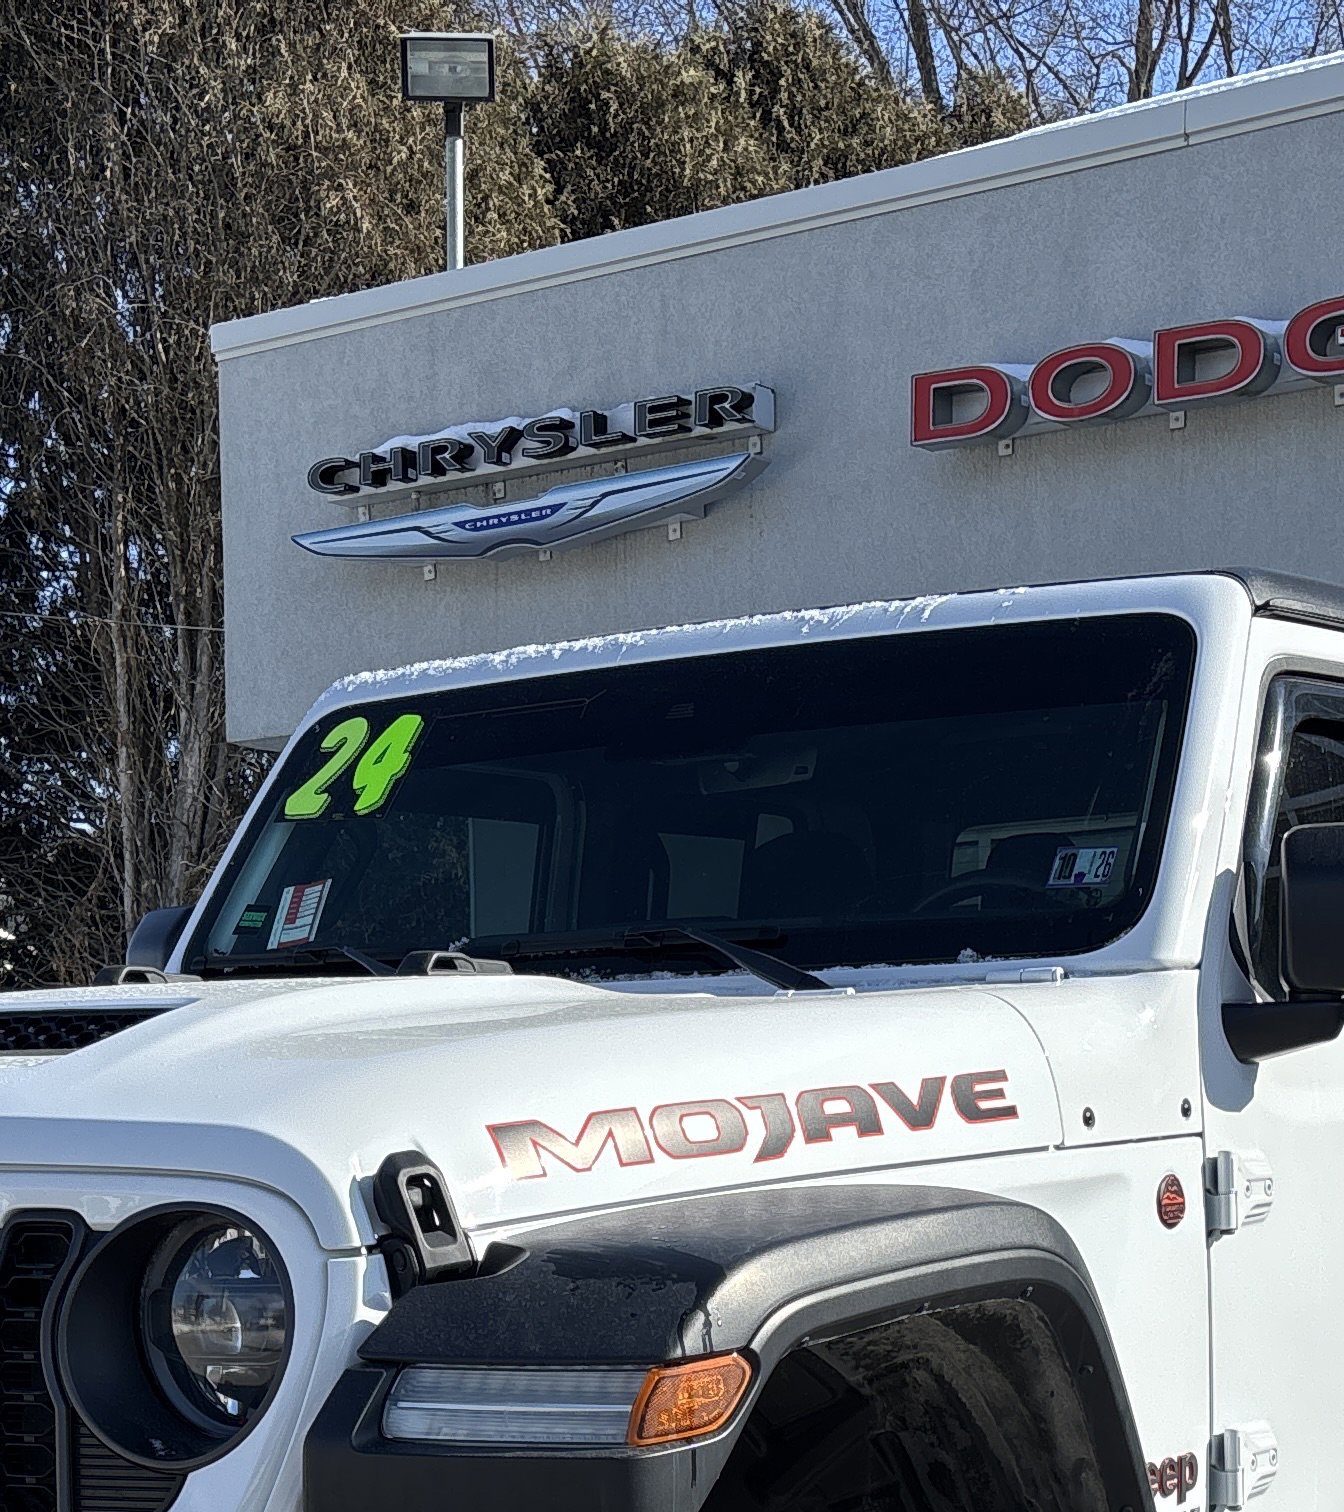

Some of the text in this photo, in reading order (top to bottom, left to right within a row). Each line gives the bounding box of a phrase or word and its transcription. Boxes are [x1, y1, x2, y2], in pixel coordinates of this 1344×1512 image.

[307, 386, 756, 495] CHRYSLER
[464, 507, 554, 530] CHRYSLER
[284, 713, 425, 820] 24
[1093, 850, 1115, 879] 26
[485, 1069, 1020, 1181] MOJAVE
[1145, 1452, 1199, 1506] eep
